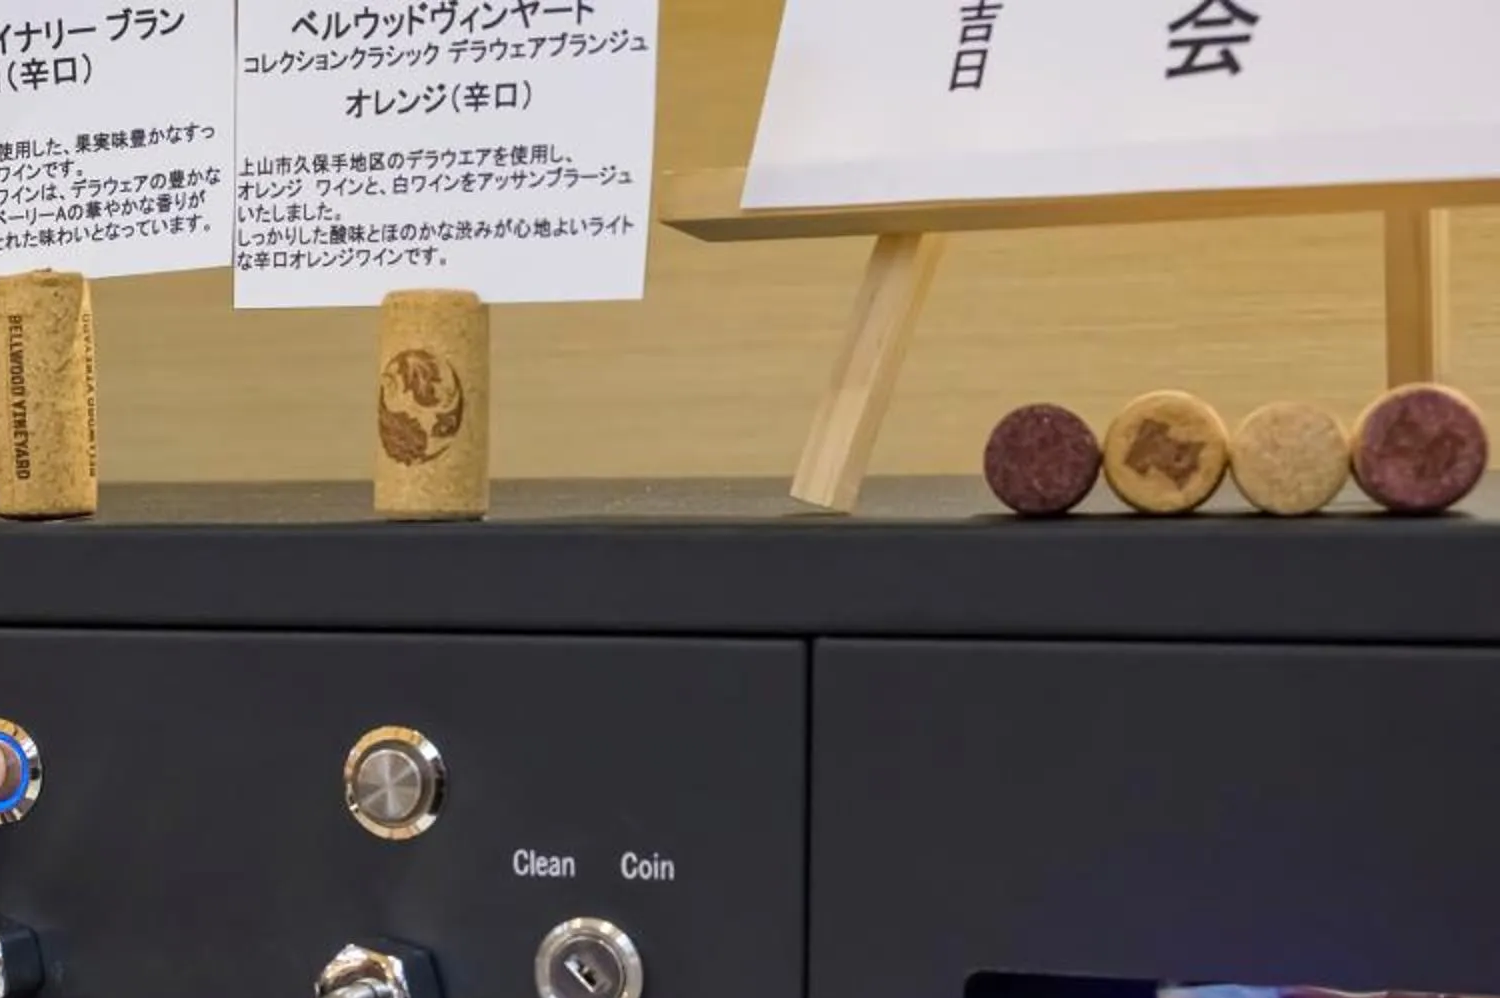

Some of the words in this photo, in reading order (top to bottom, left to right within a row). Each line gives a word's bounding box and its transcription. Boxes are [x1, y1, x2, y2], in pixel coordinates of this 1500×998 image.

[106, 7, 185, 42] ブラン
[243, 43, 439, 74] コレクションクラシック
[948, 0, 1004, 91] 吉日
[1165, 0, 1260, 78] 会
[8, 314, 26, 396] BELLWOOD
[11, 399, 30, 481] VINEYARD
[513, 849, 576, 877] Clean
[621, 852, 676, 880] Coin
